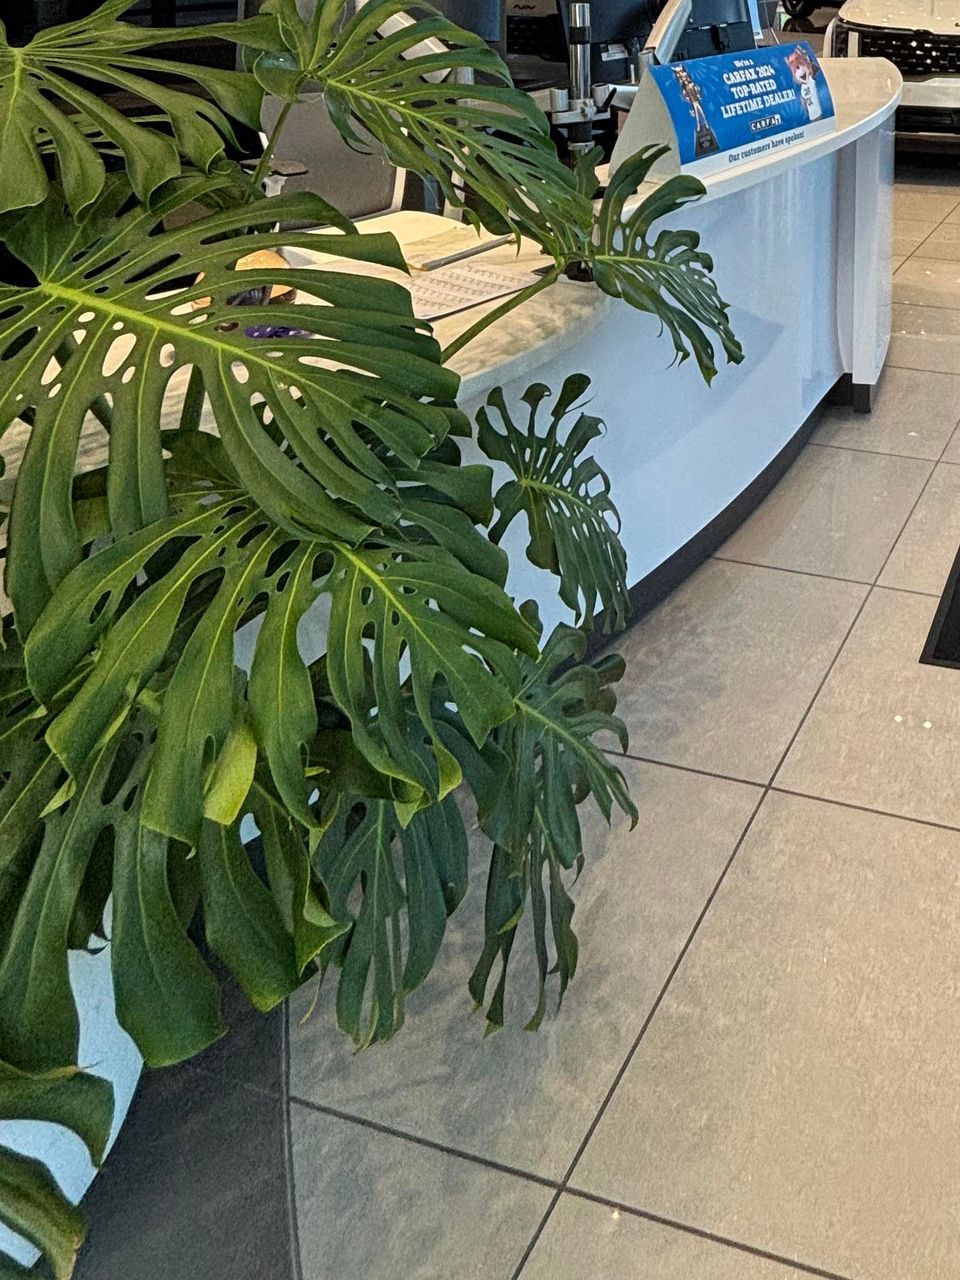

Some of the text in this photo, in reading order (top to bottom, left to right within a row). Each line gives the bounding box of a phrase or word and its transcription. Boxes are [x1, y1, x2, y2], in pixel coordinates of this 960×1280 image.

[723, 64, 776, 85] CARFAX 2024
[731, 79, 777, 99] TOP-RATED
[720, 97, 764, 118] LIFETIME
[763, 89, 796, 107] DEALER!
[751, 114, 781, 131] CARFAX
[728, 130, 805, 163] Our customers have spoken!
